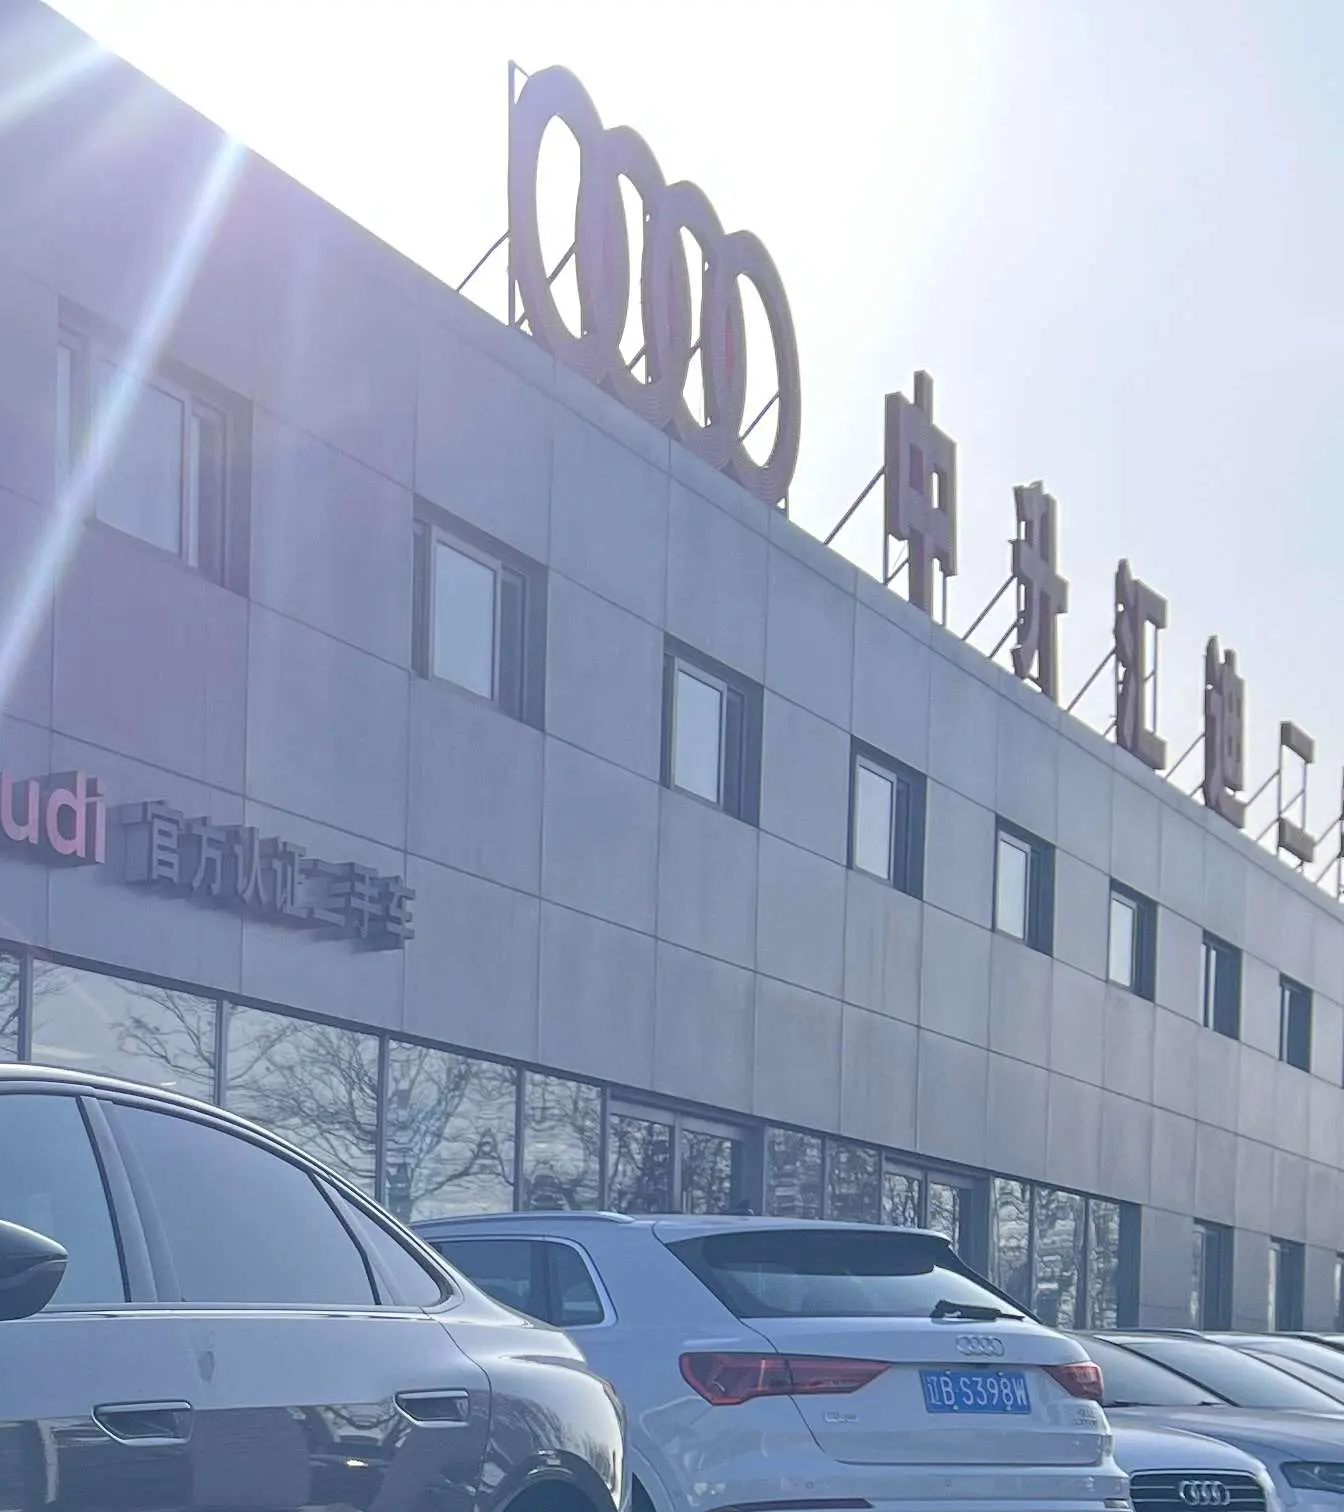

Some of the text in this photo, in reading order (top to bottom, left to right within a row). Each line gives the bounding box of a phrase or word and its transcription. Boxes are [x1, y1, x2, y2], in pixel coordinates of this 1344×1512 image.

[884, 369, 1344, 864] 中升汇迪二
[120, 799, 416, 940] 官方认证二手车
